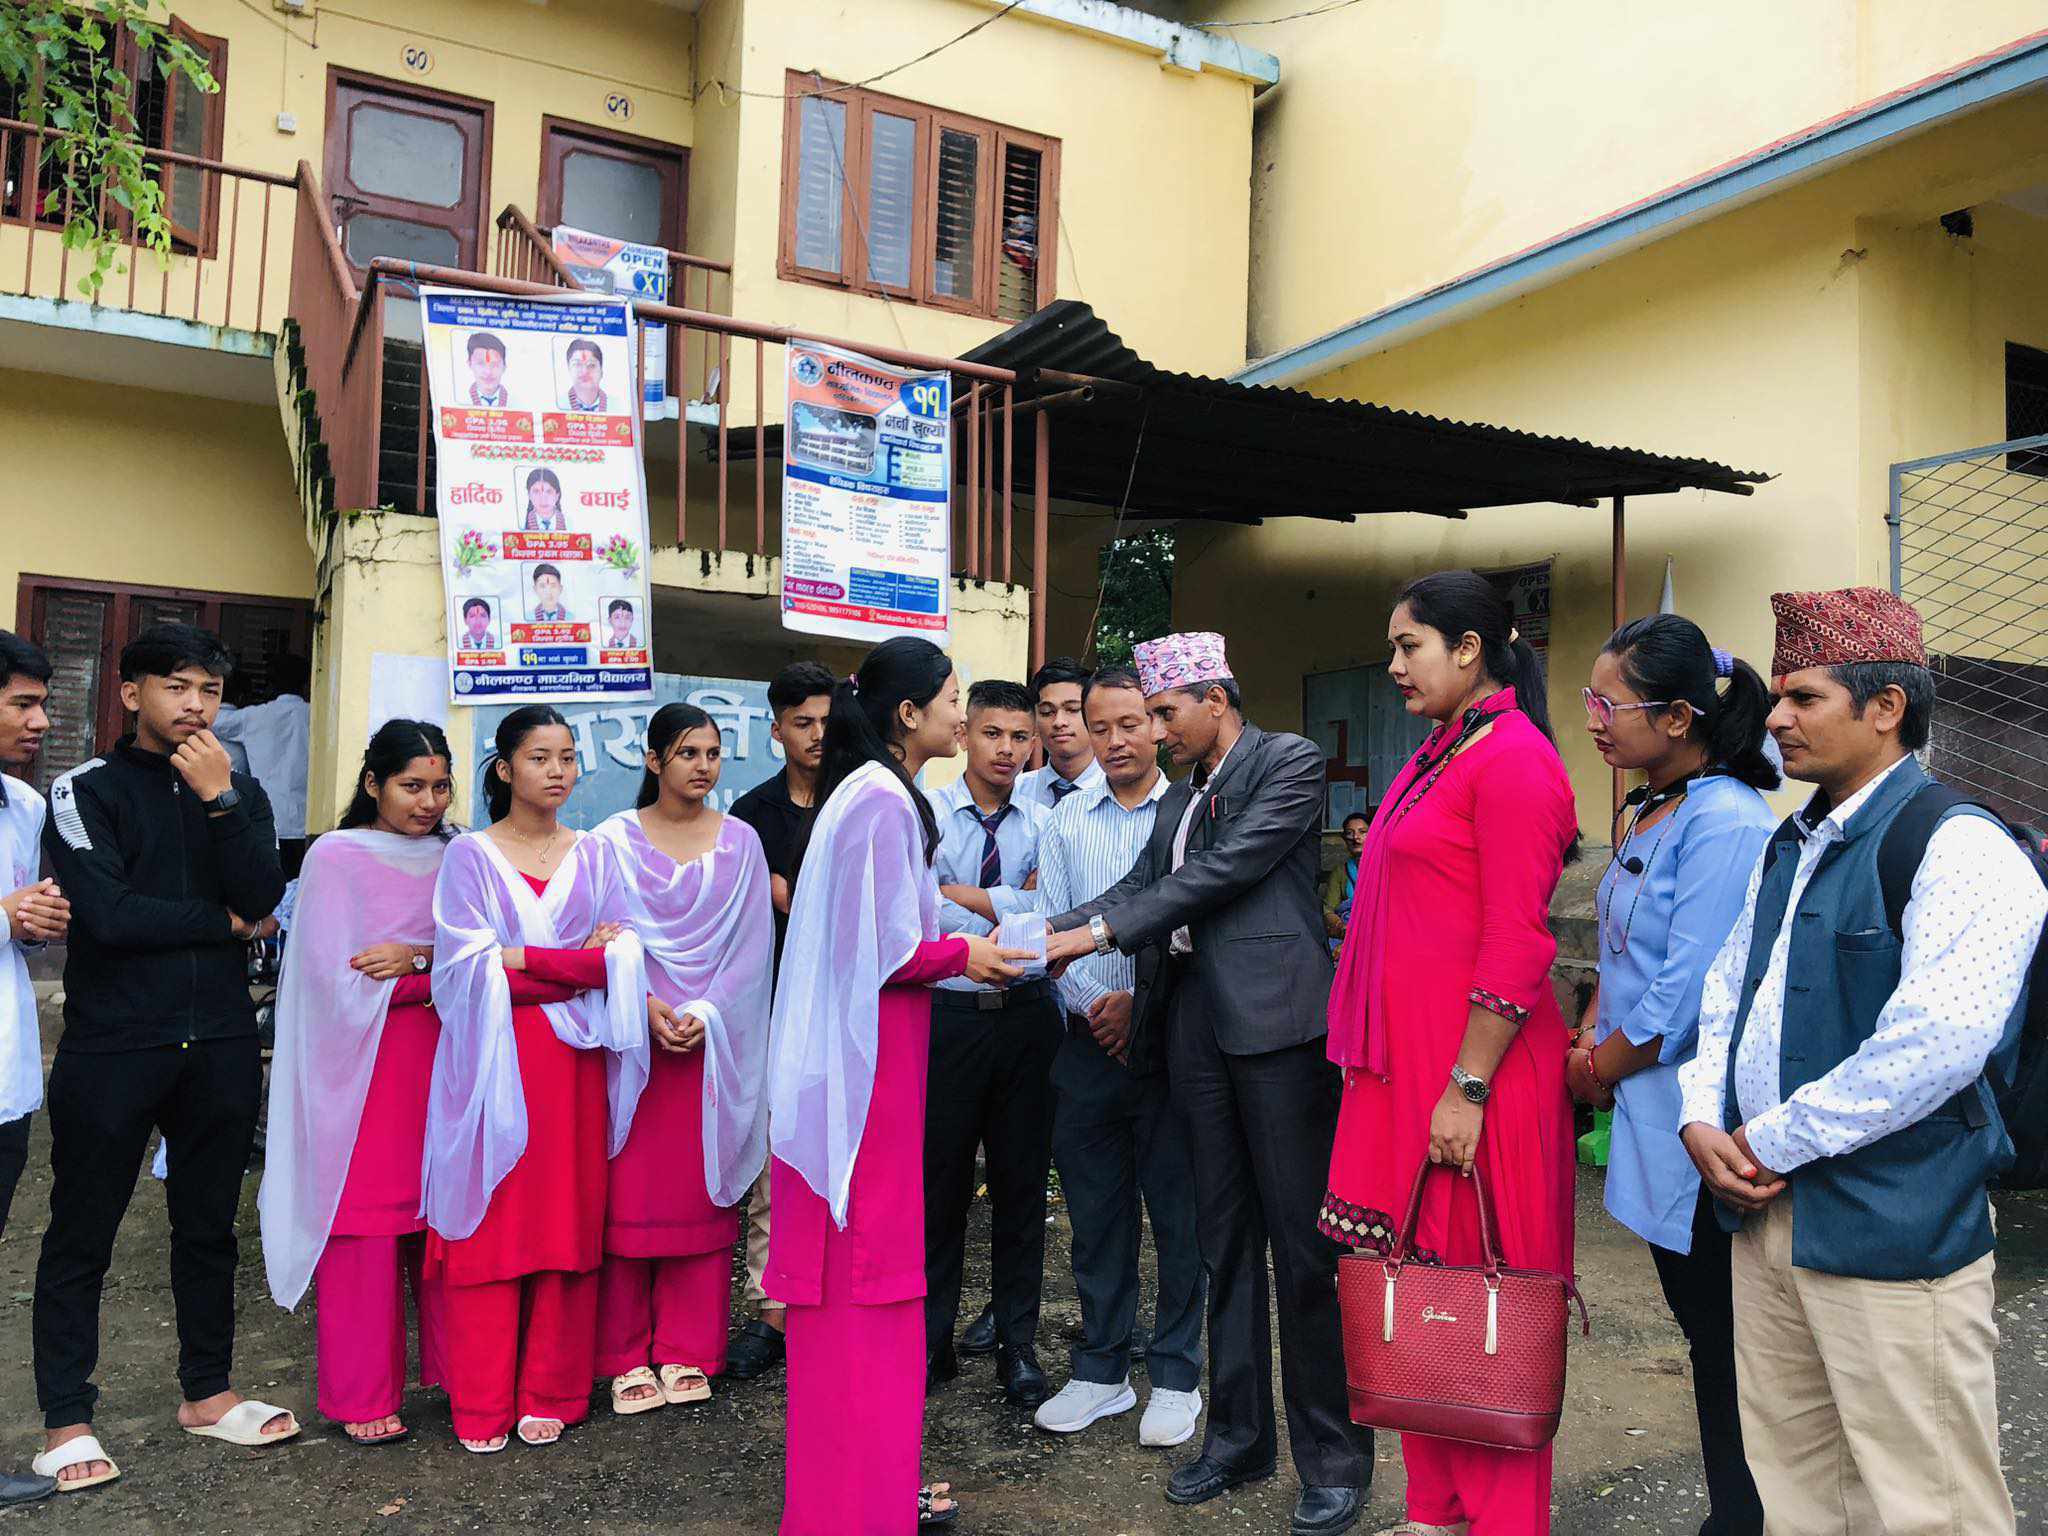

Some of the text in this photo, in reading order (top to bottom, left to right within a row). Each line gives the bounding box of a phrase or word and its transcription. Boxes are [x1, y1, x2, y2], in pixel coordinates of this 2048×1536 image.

[621, 252, 663, 270] OPEN
[642, 273, 664, 295] XI
[827, 361, 895, 391] नीलकण्ठ
[912, 385, 941, 417] ११
[450, 482, 503, 505] हार्दिक
[579, 488, 632, 511] बधाई
[526, 540, 546, 548] GPA
[795, 582, 815, 594] more
[816, 583, 841, 597] details
[523, 652, 538, 665] ११
[475, 670, 647, 687] नीलकण्ठ माध्यमिक विद्यालय
